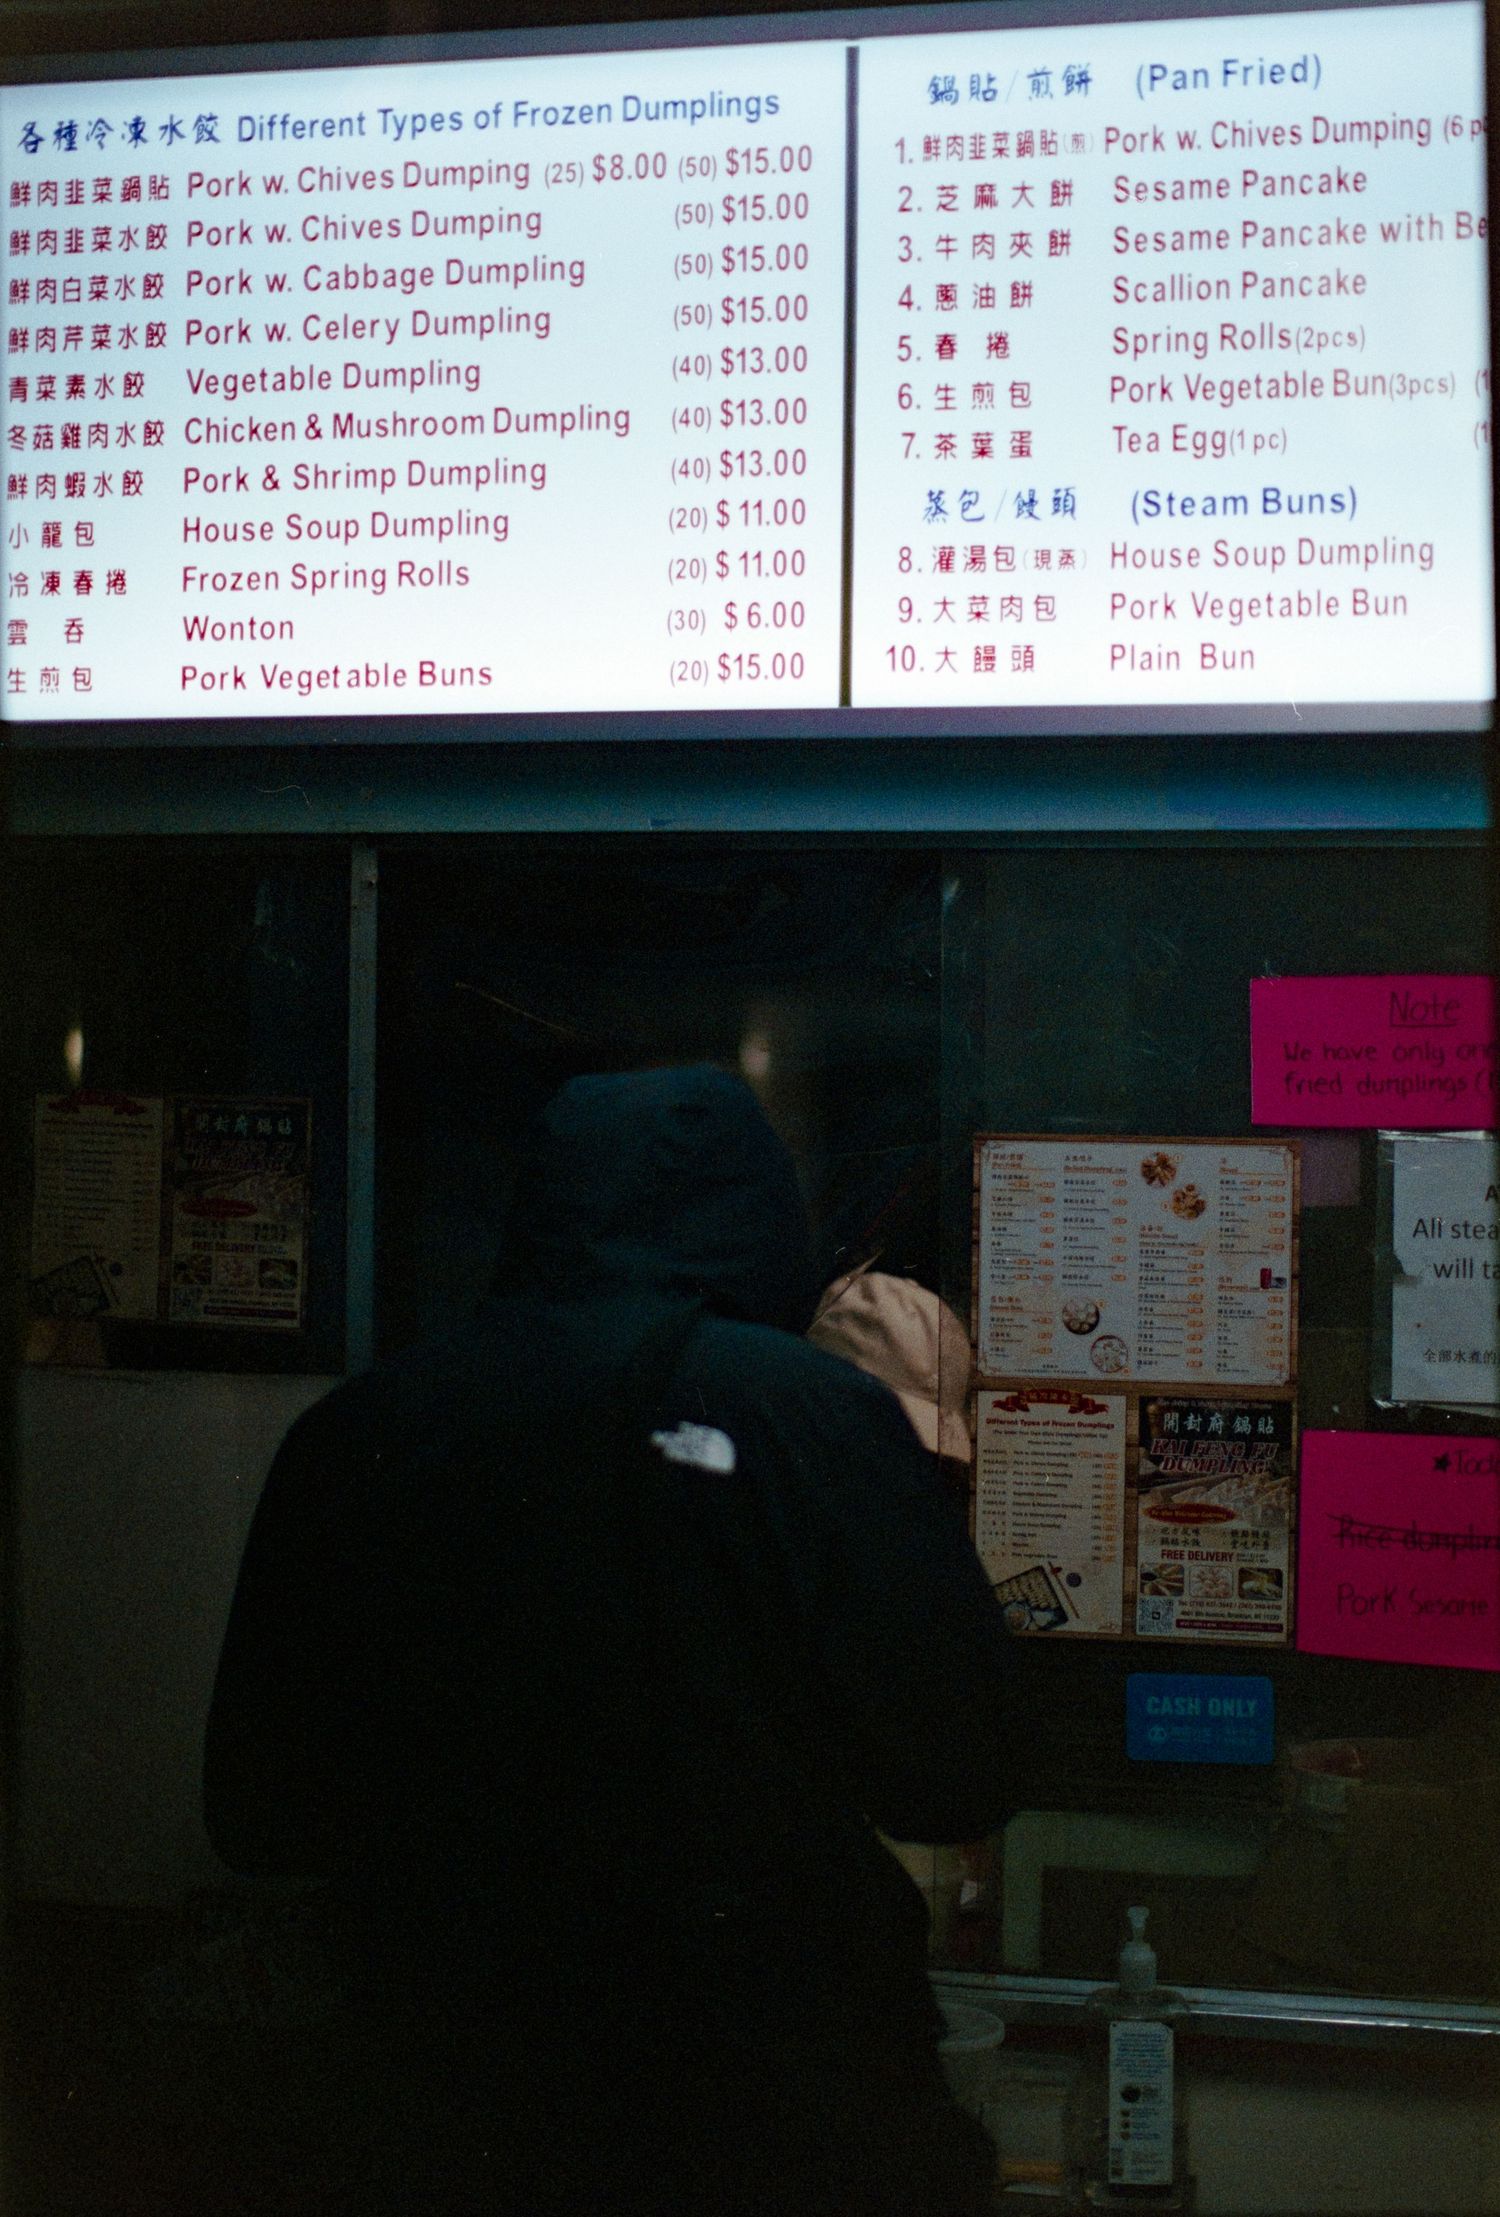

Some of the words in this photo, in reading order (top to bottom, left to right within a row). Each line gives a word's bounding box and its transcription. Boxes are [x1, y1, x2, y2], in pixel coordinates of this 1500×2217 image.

[1136, 64, 1209, 100] (Pan
[1223, 54, 1321, 89] Fried)
[17, 112, 221, 154] 各種冷凍水餃
[238, 112, 366, 143] Different
[377, 108, 463, 142] Types
[474, 102, 503, 130] of
[514, 101, 612, 127] Frozen
[623, 90, 779, 126] Dumplings
[895, 137, 913, 164] 1.
[1104, 125, 1165, 154] Pork
[1176, 130, 1201, 150] w.
[1211, 120, 1302, 149] Chives
[1312, 112, 1431, 149] Dumping
[10, 174, 170, 208] 鮮肉韭菜鍋貼
[188, 169, 252, 199] Pork
[262, 175, 288, 195] w.
[297, 166, 394, 193] Chives
[403, 159, 530, 192] Dumping
[545, 162, 584, 189] (25)
[592, 152, 667, 184] $8.00
[679, 156, 717, 182] (50)
[726, 145, 812, 178] $15.00
[898, 185, 922, 213] 2.
[936, 179, 1073, 212] 芝麻大餅
[1114, 175, 1230, 204] Sesame
[1242, 166, 1367, 197] Pancake
[9, 223, 168, 257] 鮮肉韭菜水餃
[187, 219, 253, 247] Pork
[264, 224, 291, 244] w.
[301, 214, 401, 242] Chives
[411, 207, 541, 241] Dumping
[675, 203, 713, 230] (50)
[722, 192, 809, 225] $15.00
[898, 235, 922, 263] 3.
[936, 229, 1071, 261] 牛肉夾餅
[1113, 225, 1230, 254] Sesame
[1242, 217, 1366, 248] Pancake
[1380, 213, 1443, 243] with
[8, 272, 164, 305] 鮮肉白菜水餃
[186, 268, 252, 297] Pork
[265, 273, 292, 293] w.
[303, 262, 434, 295] Cabbage
[446, 255, 585, 290] Dumpling
[674, 253, 713, 280] (50)
[721, 243, 808, 276] $15.00
[898, 284, 921, 311] 4.
[1113, 273, 1230, 304] Scallion
[1242, 268, 1366, 299] Pancake
[8, 321, 167, 355] 鮮肉芹菜水餃
[186, 317, 251, 346] Pork
[264, 323, 291, 343] w.
[303, 313, 400, 346] Celery
[412, 306, 550, 341] Dumpling
[674, 304, 712, 331] (50)
[721, 294, 808, 326] $15.00
[897, 335, 921, 362] 5.
[935, 331, 1010, 361] 春捲
[1113, 326, 1208, 362] Spring
[8, 371, 145, 403] 青菜素水餃
[186, 364, 332, 401] Vegetable
[343, 359, 480, 394] Dumpling
[672, 355, 712, 381] (40)
[721, 345, 807, 377] $13.00
[898, 383, 920, 410] 6.
[934, 380, 1032, 411] 生煎包
[1110, 374, 1173, 403] Pork
[1184, 370, 1324, 409] Vegetable
[6, 419, 165, 451] 冬菇雞肉水餃
[184, 416, 296, 445] Chicken
[304, 413, 323, 441] &
[333, 411, 484, 439] Mushroom
[493, 404, 630, 439] Dumpling
[672, 407, 711, 433] (40)
[720, 397, 807, 430] $13.00
[901, 432, 920, 459] 7.
[934, 430, 1032, 460] 茶葉蛋
[1112, 425, 1160, 453] Tea
[6, 469, 144, 501] 鮮肉蝦水餃
[184, 465, 249, 494] Pork
[262, 464, 281, 492] &
[293, 462, 396, 495] Shrimp
[408, 457, 546, 492] Dumpling
[672, 458, 711, 485] (40)
[720, 448, 806, 480] $13.00
[1132, 489, 1248, 525] (Steam
[1262, 485, 1357, 520] Buns)
[8, 521, 95, 549] 小籠包
[183, 516, 274, 543] House
[286, 513, 360, 546] Soup
[371, 509, 509, 544] Dumpling
[669, 507, 707, 533] (20)
[898, 546, 922, 574] 8.
[1111, 542, 1200, 569] House
[1213, 539, 1285, 573] Soup
[1298, 536, 1433, 572] Dumpling
[8, 568, 127, 598] 冷凍春捲
[182, 566, 279, 592] Frozen
[291, 562, 386, 597] Spring
[398, 560, 470, 587] Rolls
[668, 558, 707, 584] (20)
[183, 615, 294, 642] Wonton
[667, 609, 705, 635] (30)
[898, 596, 921, 624] 9.
[934, 594, 1056, 623] 大菜肉包
[1111, 592, 1176, 620] Pork
[1191, 590, 1339, 626] Vegetable
[1352, 588, 1407, 616] Bun
[7, 666, 93, 694] 生煎包
[181, 665, 247, 691] Pork
[260, 662, 407, 697] Vegetable
[419, 660, 492, 687] Buns
[670, 660, 708, 686] (20)
[718, 652, 804, 682] $15.00
[886, 645, 924, 672] 10.
[935, 644, 1034, 673] 大饅頭
[1111, 644, 1180, 671] Plain
[1200, 642, 1254, 670] Bun
[1391, 990, 1466, 1024] Note
[1283, 1041, 1311, 1062] We
[1322, 1042, 1378, 1062] have
[1391, 1041, 1445, 1067] only
[1433, 1257, 1474, 1279] will
[1161, 1549, 1185, 1561] FREE
[1188, 1551, 1234, 1563] DELIVERY
[1146, 1695, 1201, 1716] CASH
[1208, 1697, 1257, 1718] ONLY
